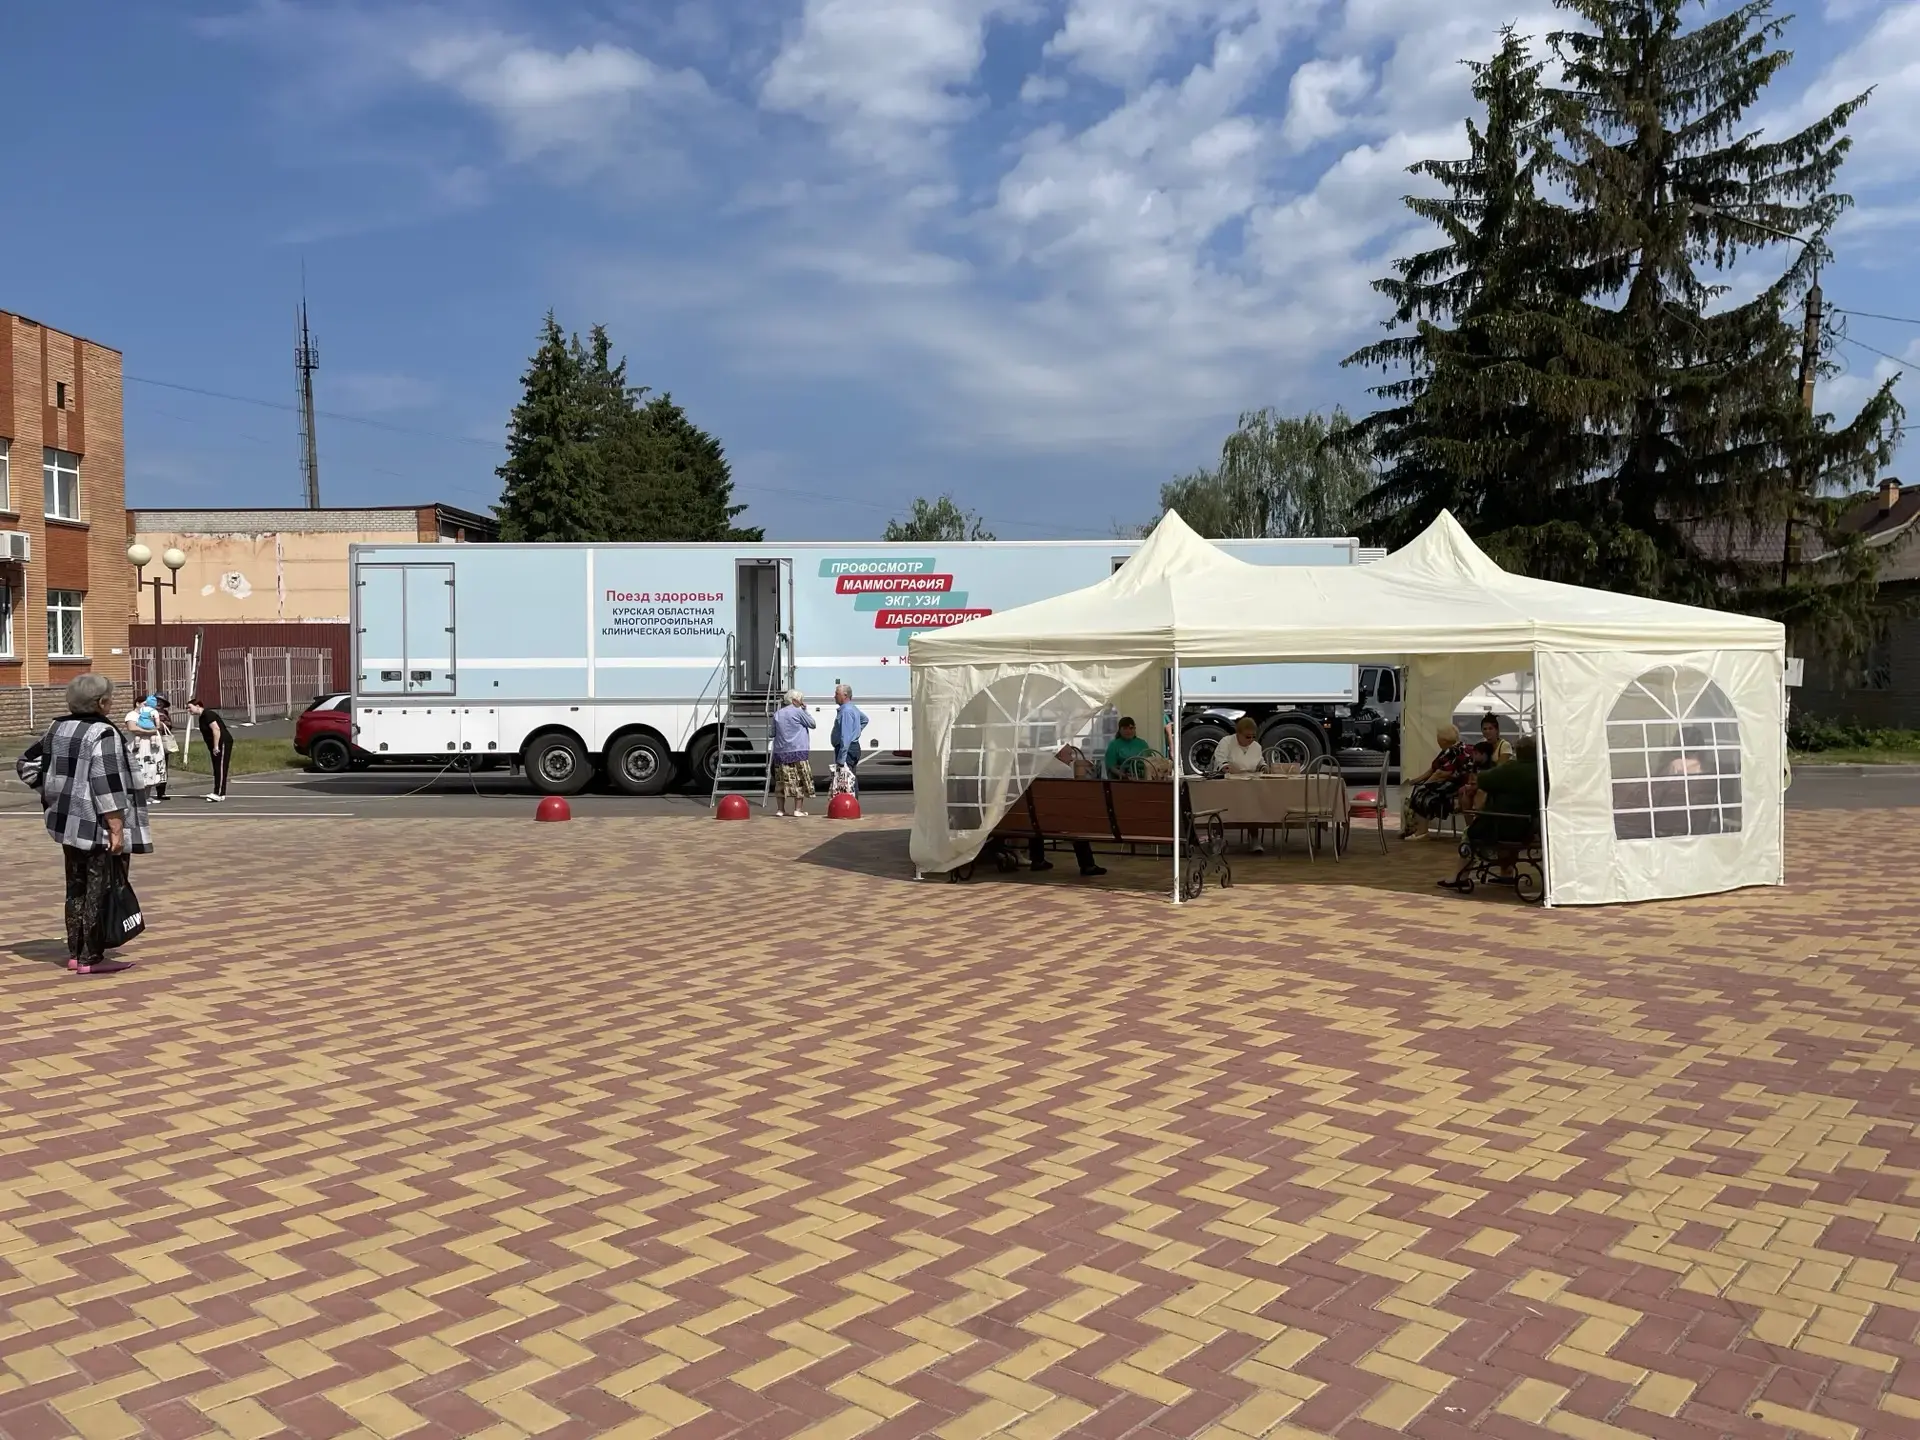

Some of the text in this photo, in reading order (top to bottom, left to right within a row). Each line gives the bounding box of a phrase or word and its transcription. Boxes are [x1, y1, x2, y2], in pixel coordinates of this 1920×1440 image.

[831, 562, 924, 573] ПРОФОСМОТР
[843, 579, 945, 590] МАММОГРАФИЯ
[606, 590, 724, 604] Поезд здоровья
[885, 595, 941, 607] ЭКГ, УЗИ
[673, 628, 726, 636] БОЛЬНИЦА
